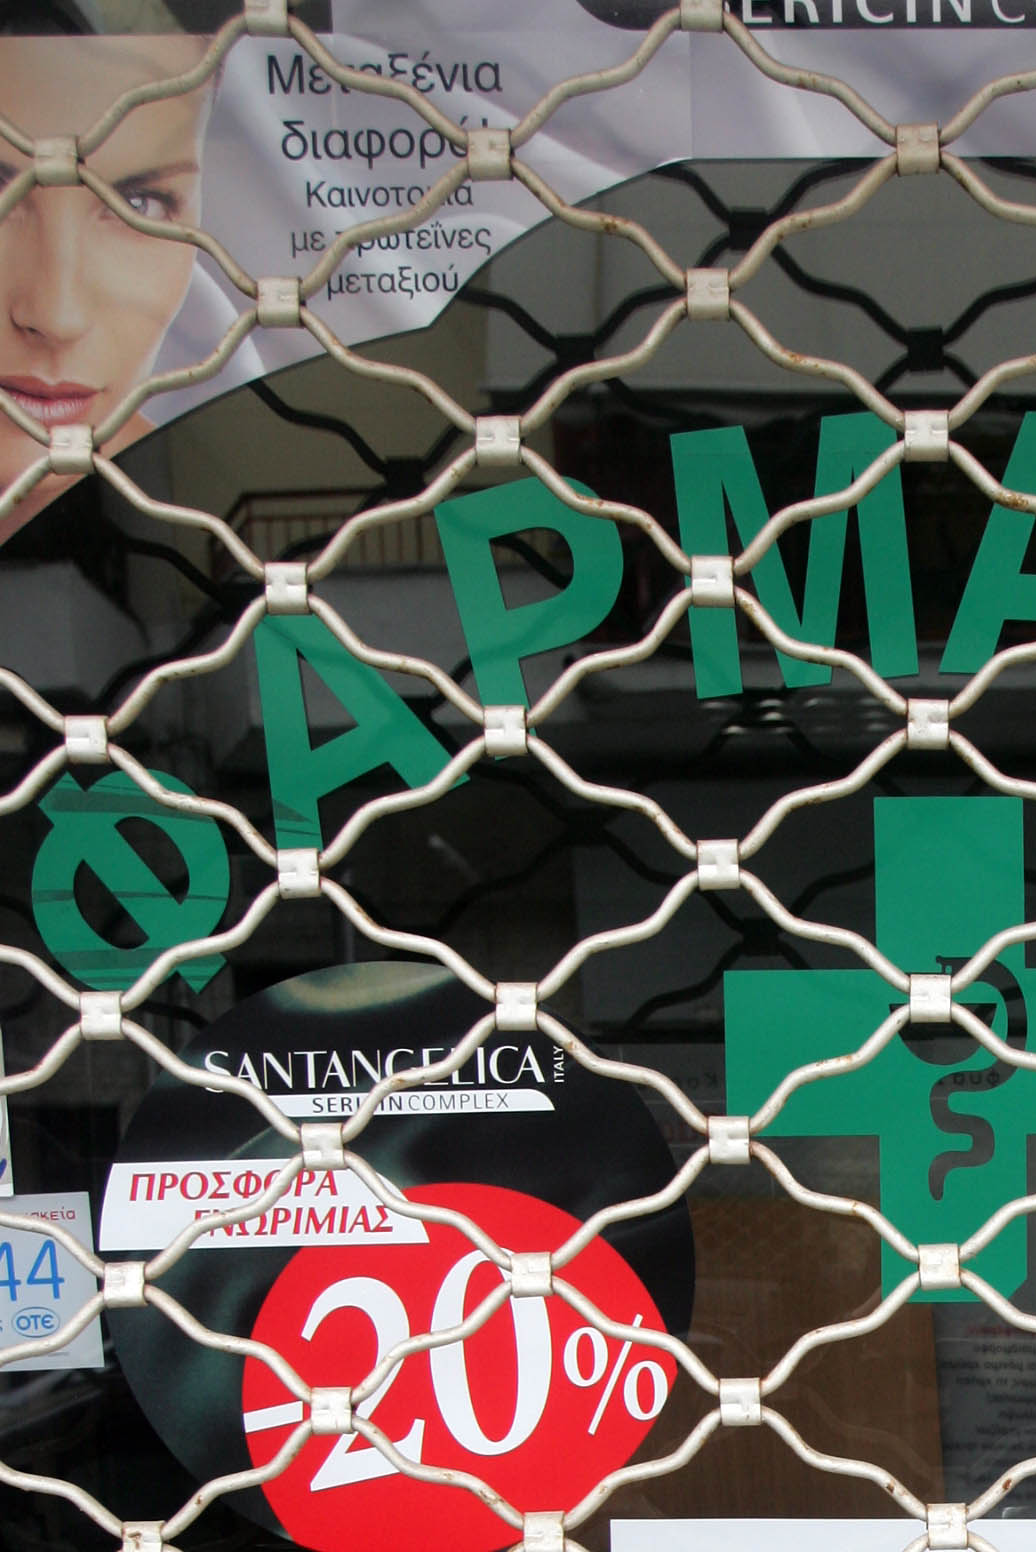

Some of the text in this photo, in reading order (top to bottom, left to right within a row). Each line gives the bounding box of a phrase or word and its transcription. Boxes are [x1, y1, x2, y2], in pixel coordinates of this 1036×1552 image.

[291, 231, 326, 258] με
[326, 264, 459, 301] μεταξιού
[553, 1045, 566, 1084] ITALY
[407, 1092, 511, 1111] COMPLEX
